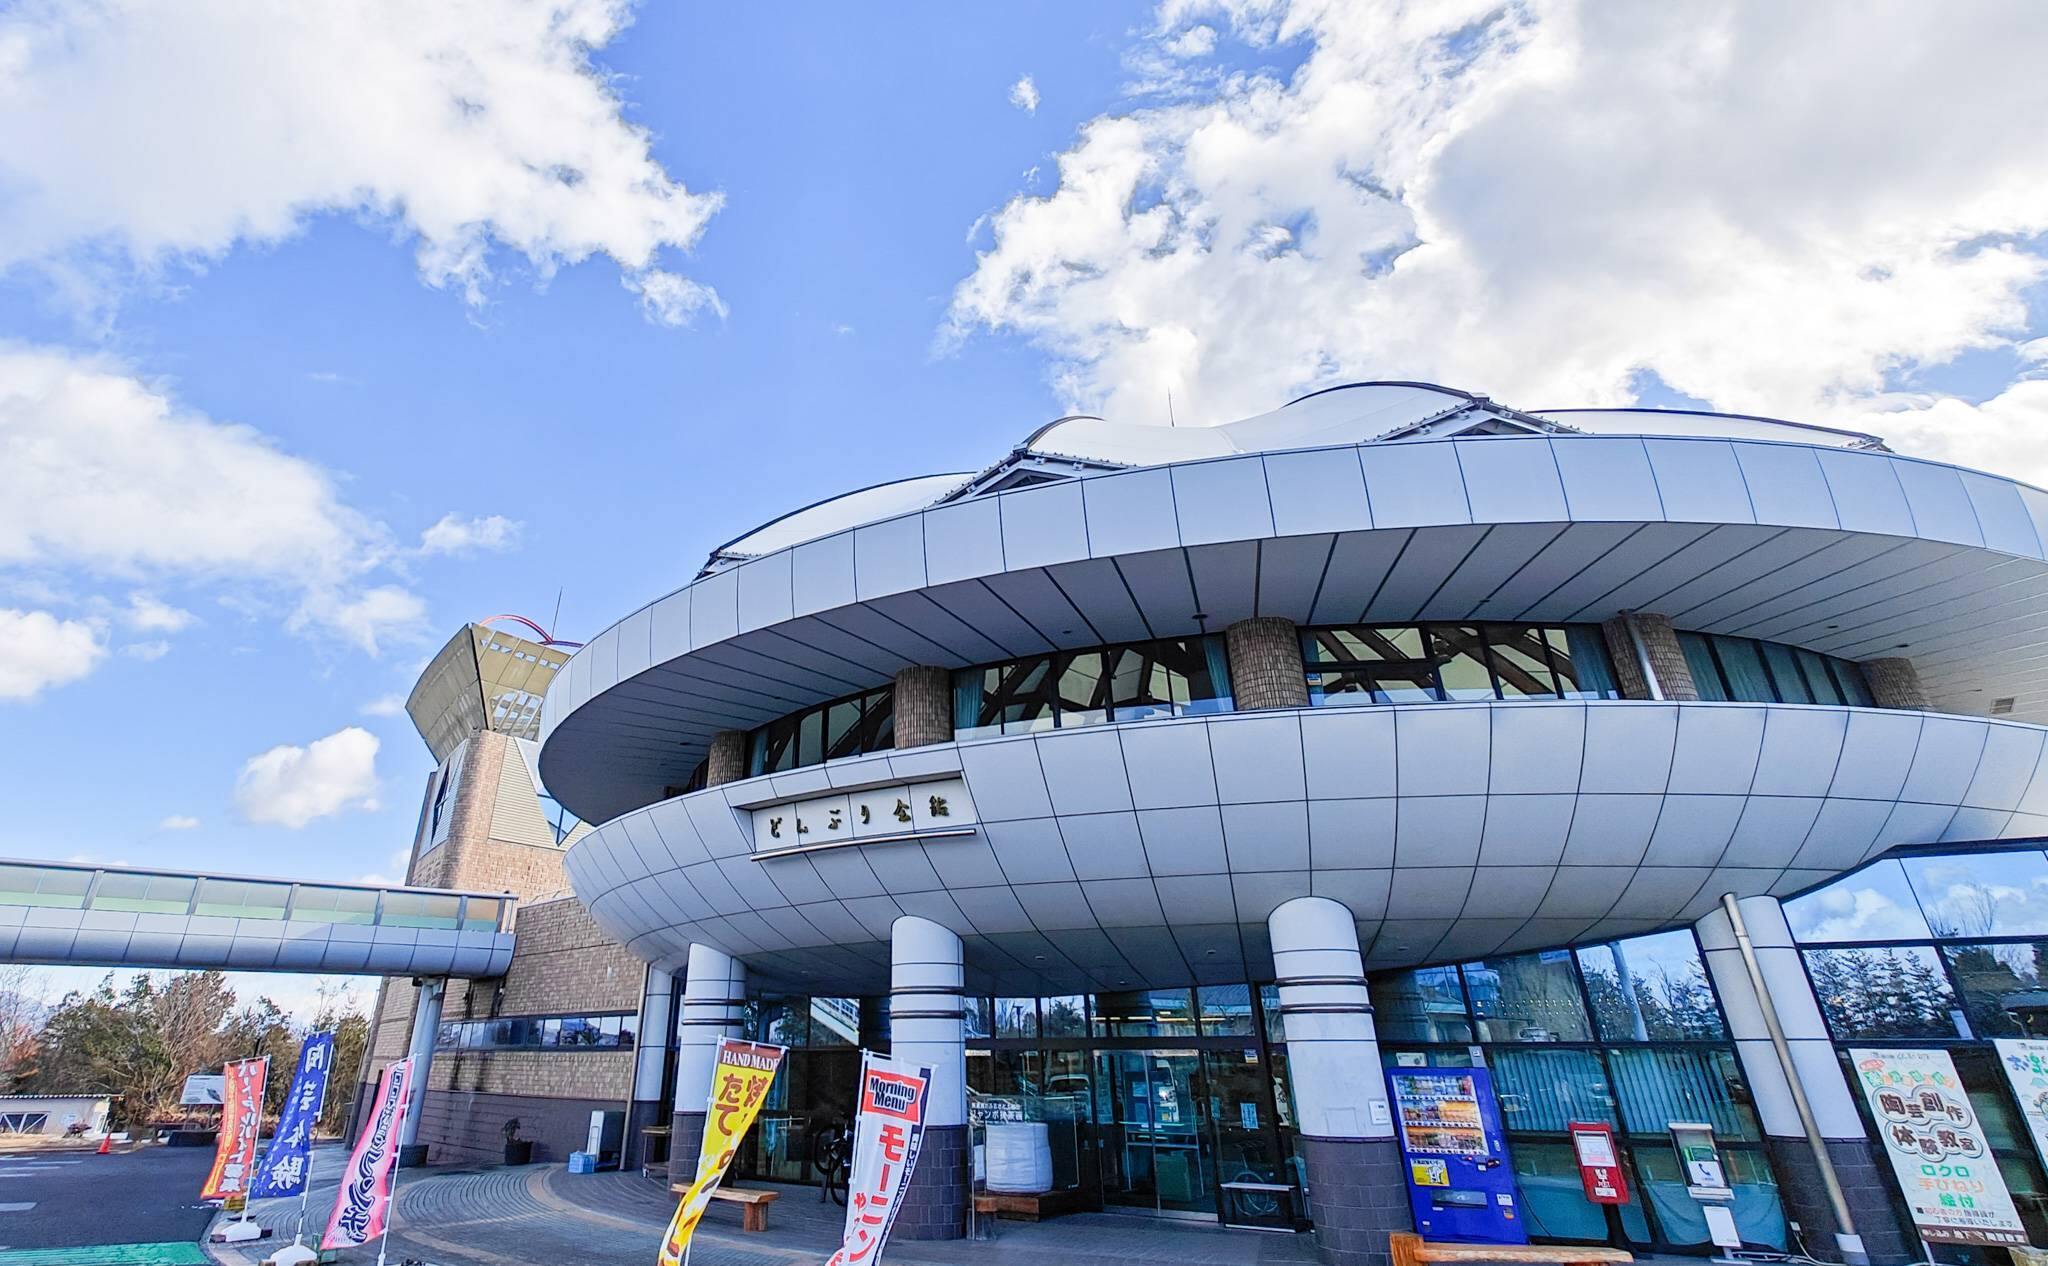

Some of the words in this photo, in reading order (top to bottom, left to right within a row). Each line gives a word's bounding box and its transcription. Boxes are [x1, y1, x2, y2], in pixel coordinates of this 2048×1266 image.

[769, 795, 950, 838] どんぶり会館
[723, 1049, 750, 1068] HAND
[751, 1055, 780, 1073] MADE
[869, 1077, 915, 1101] Morning
[715, 1073, 743, 1136] たて
[873, 1091, 906, 1112] Menu
[1879, 1091, 1965, 1122] 陶芸創作
[1892, 1125, 1976, 1155] 体験教室
[1921, 1164, 1970, 1177] ロクロ
[1919, 1177, 1985, 1193] 手ひねり
[1939, 1193, 1975, 1208] 絵付
